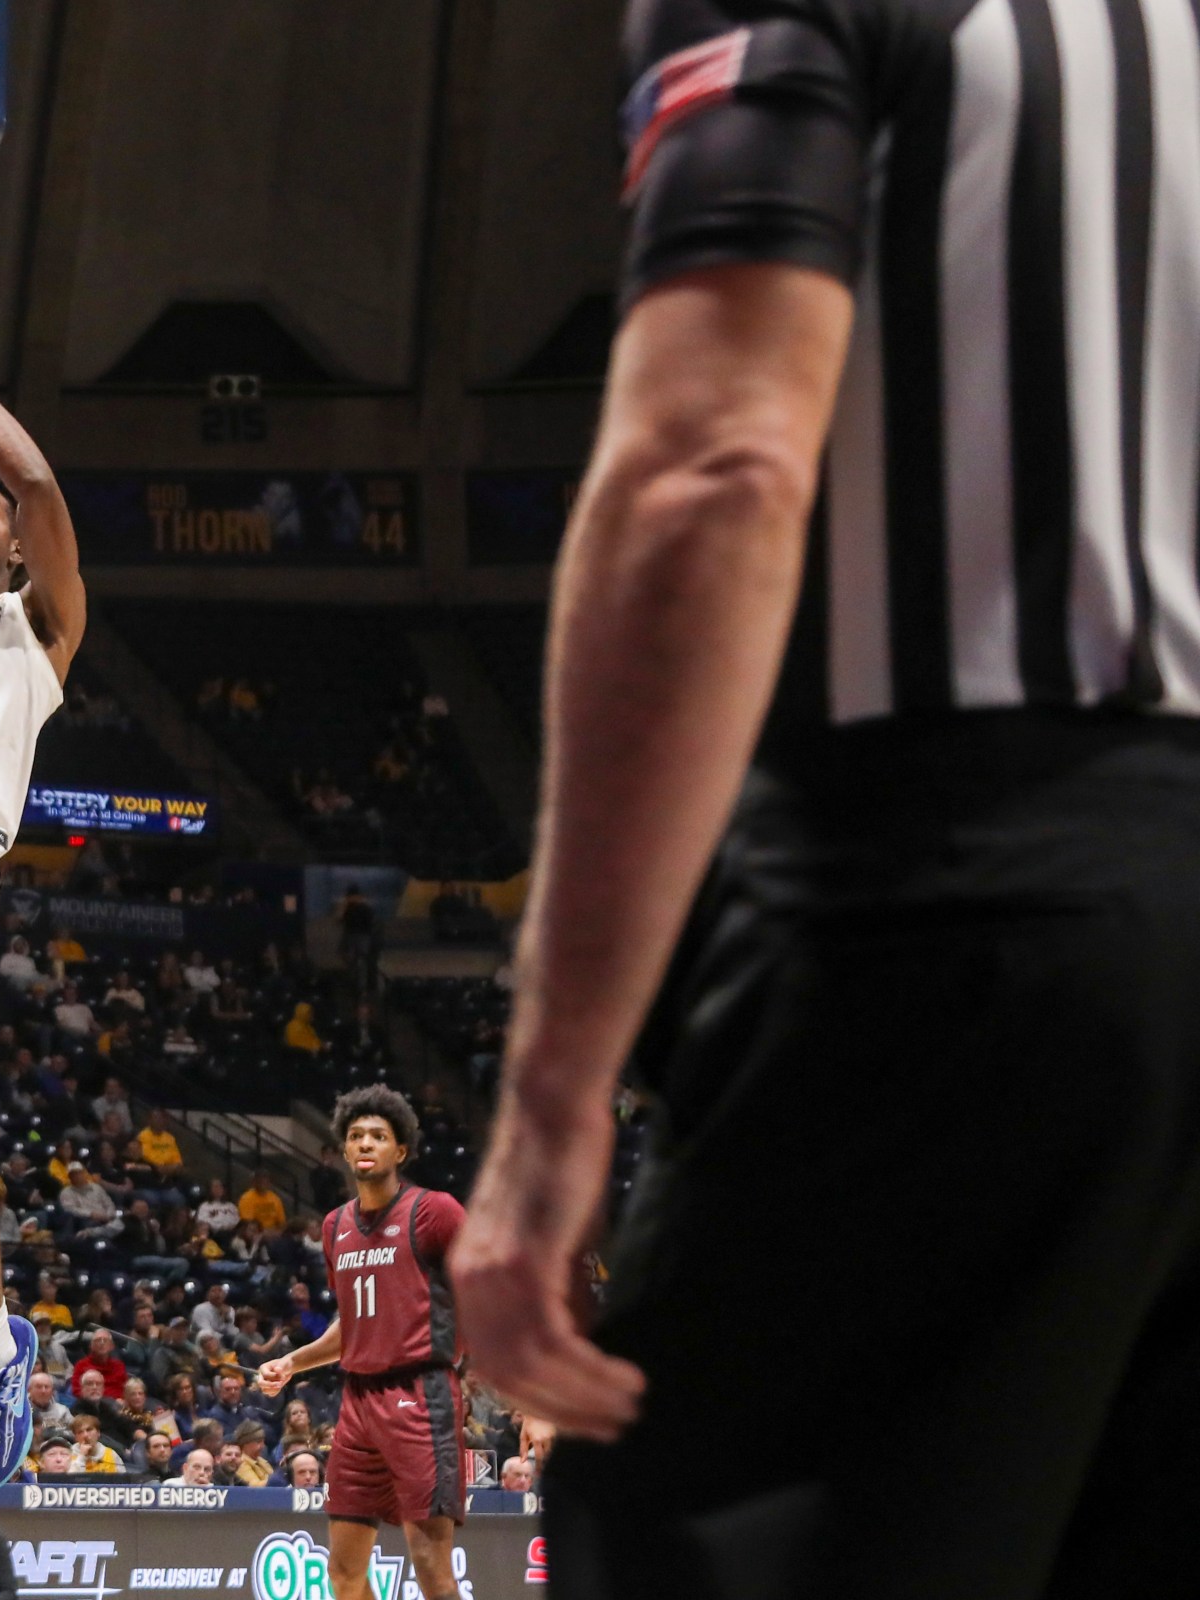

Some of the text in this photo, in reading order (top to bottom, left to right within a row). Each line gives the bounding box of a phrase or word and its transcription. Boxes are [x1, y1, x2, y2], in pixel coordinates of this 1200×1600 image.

[202, 405, 267, 443] 215
[150, 508, 272, 553] THORN
[363, 510, 406, 552] 44
[30, 788, 207, 816] LOTTERY YOUR WAY
[113, 811, 147, 823] Online
[336, 1246, 397, 1271] LITTLE ROCK
[353, 1274, 376, 1318] 11
[44, 1487, 229, 1508] DIVERSIFIED ENERGY
[130, 1567, 248, 1589] EXCLUSIVELY AT
